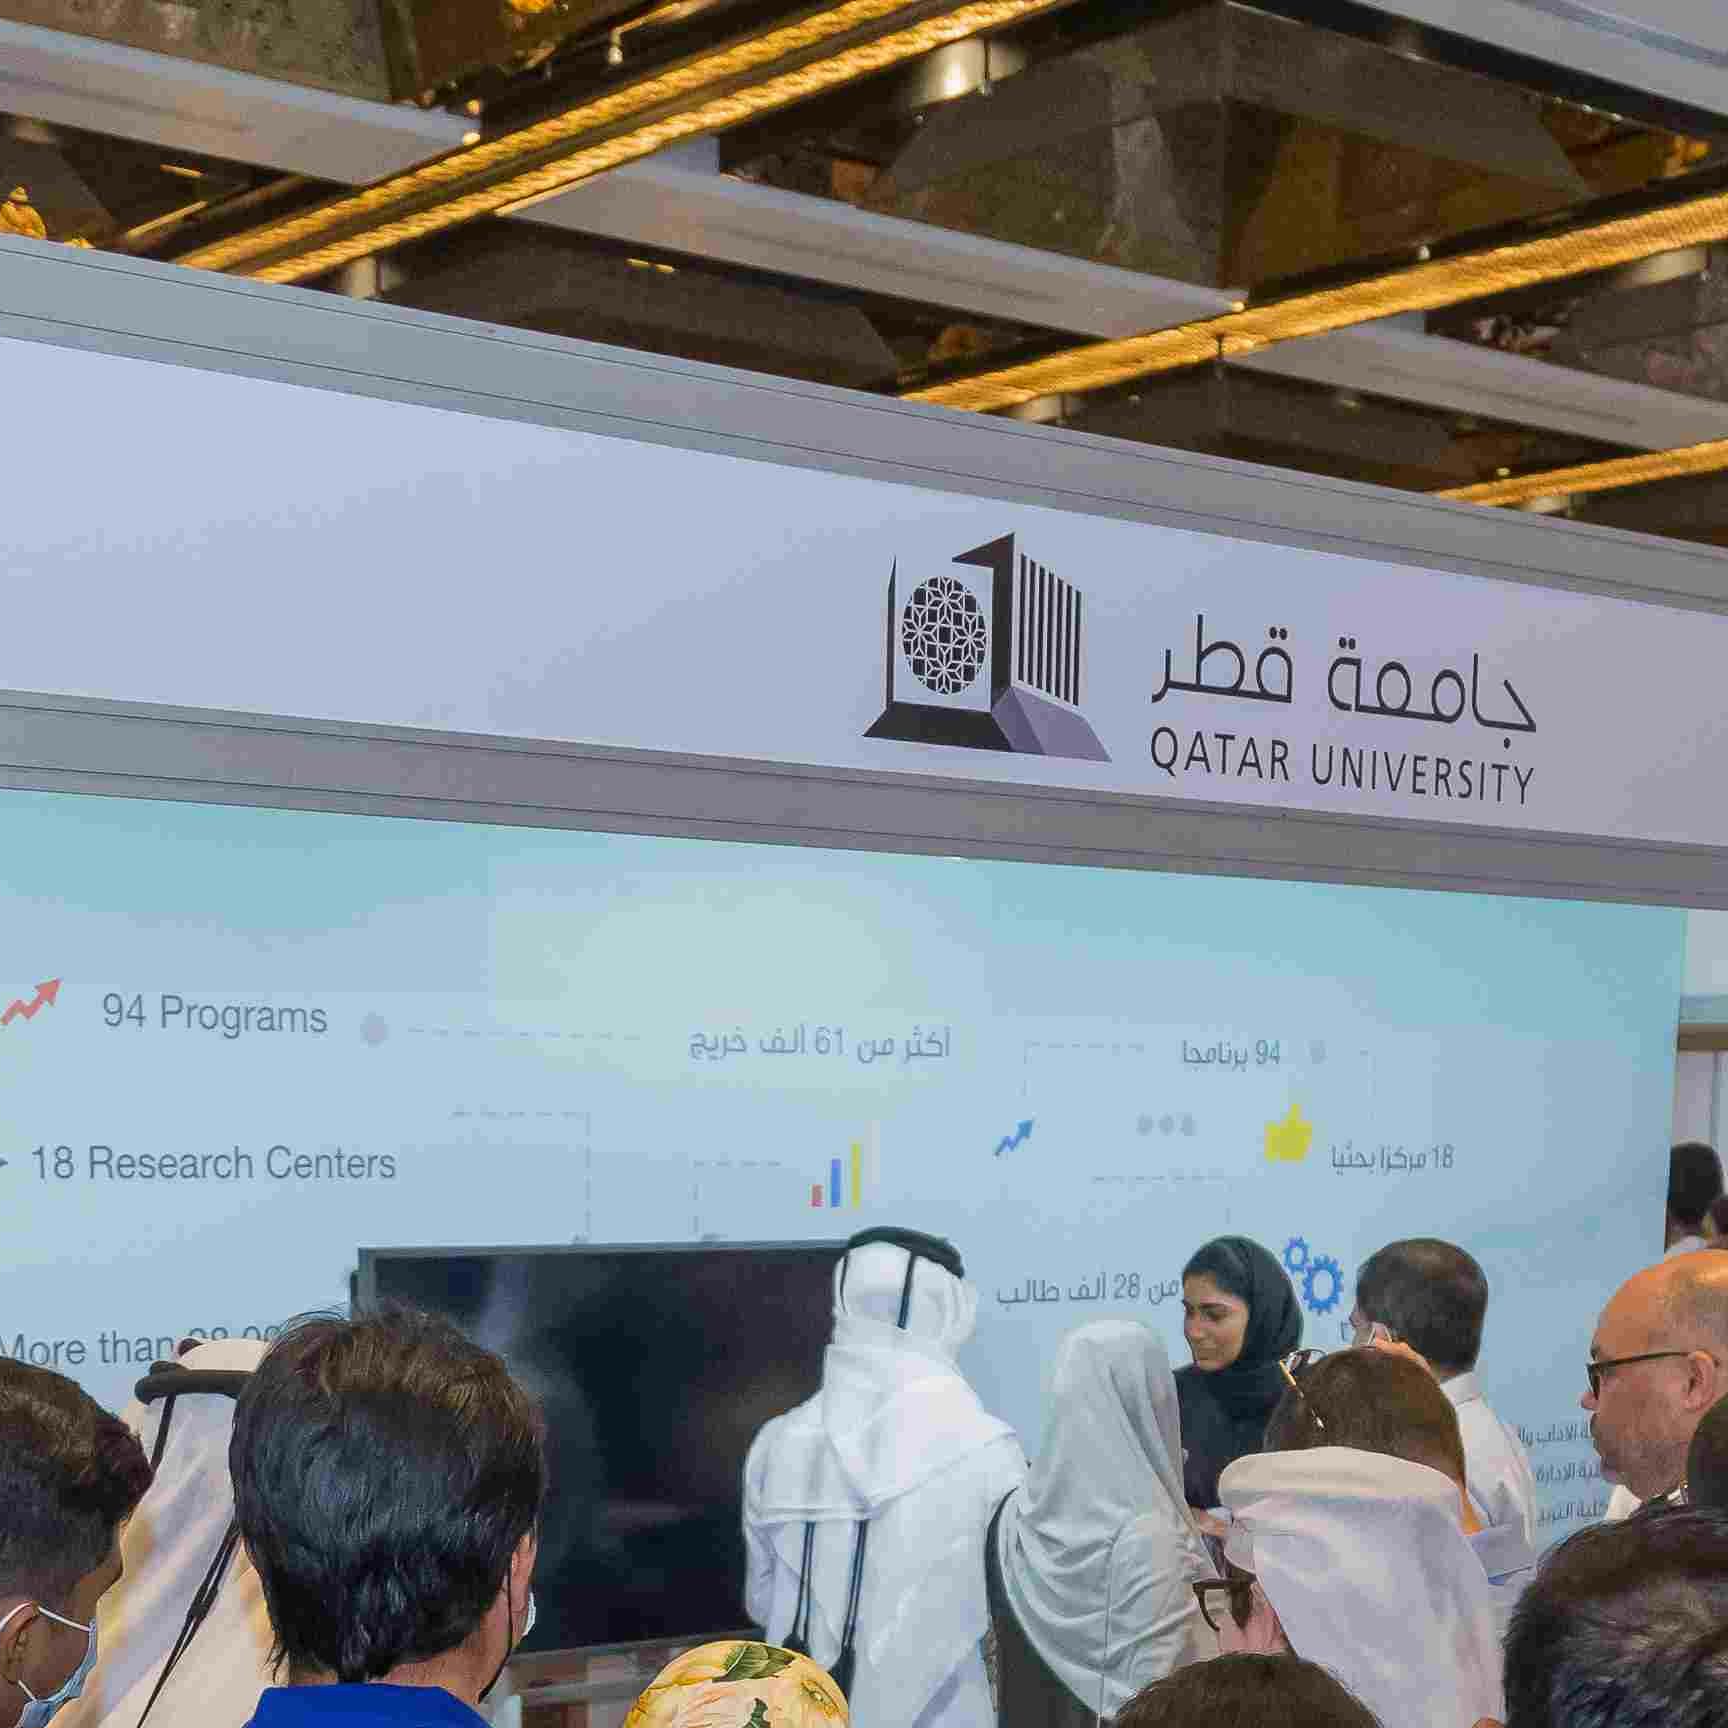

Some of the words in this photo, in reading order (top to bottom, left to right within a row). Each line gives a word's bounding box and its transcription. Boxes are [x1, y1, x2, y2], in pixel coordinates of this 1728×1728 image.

[1152, 614, 1292, 704] قطر
[1328, 636, 1536, 750] جامعة
[1151, 727, 1290, 781] QATAR
[1312, 743, 1534, 804] UNIVERSITY
[103, 992, 146, 1027] 94
[161, 994, 328, 1039] Programs
[689, 1026, 748, 1061] خريج
[760, 1022, 806, 1055] ألف
[815, 1026, 845, 1056] 61
[857, 1033, 895, 1064] من
[903, 1023, 951, 1064] أكثر
[1255, 1040, 1281, 1065] 94
[32, 1145, 73, 1180] 18
[89, 1145, 253, 1180] Research
[266, 1145, 396, 1180] Centers
[1433, 1143, 1455, 1169] 18
[997, 1279, 1060, 1312] طالب
[1069, 1271, 1107, 1300] ألف
[1113, 1272, 1141, 1299] 28
[98, 1330, 174, 1364] than
